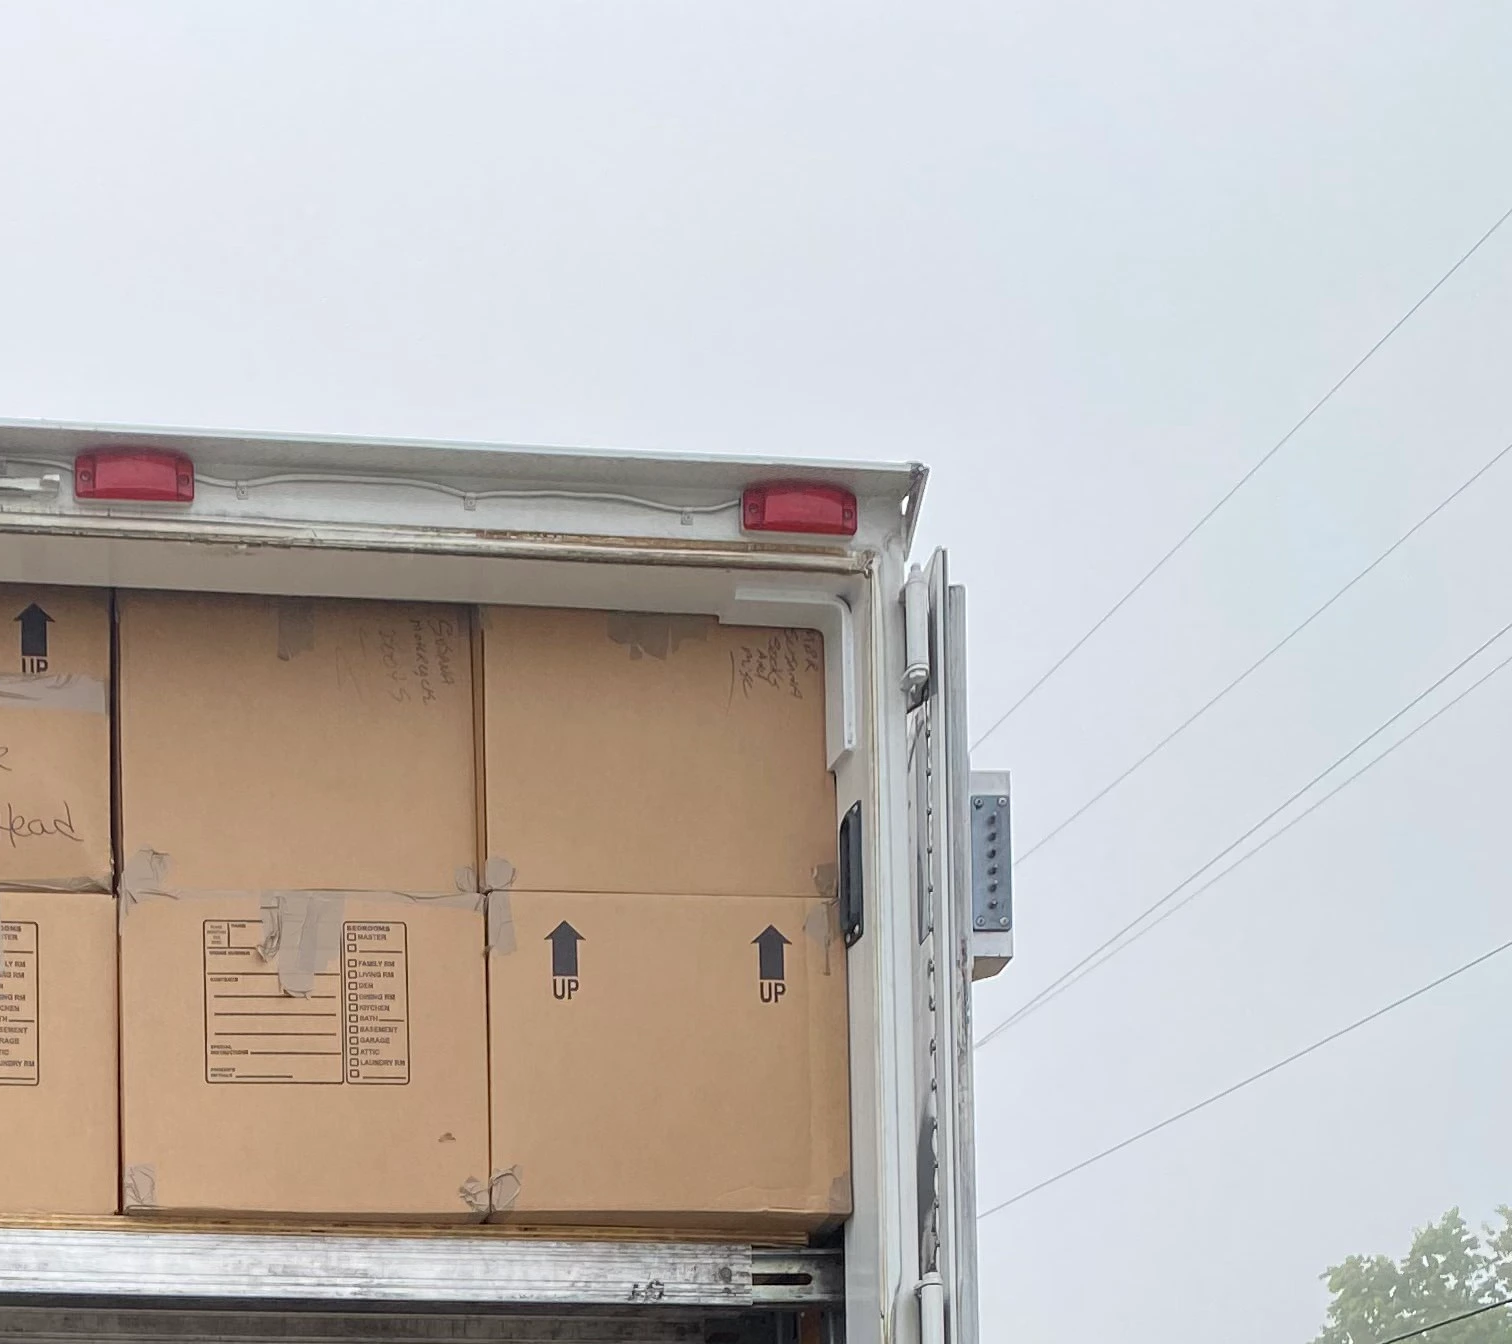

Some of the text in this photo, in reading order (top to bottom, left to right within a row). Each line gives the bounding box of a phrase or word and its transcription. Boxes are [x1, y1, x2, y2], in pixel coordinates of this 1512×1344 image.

[21, 658, 49, 674] UP
[357, 933, 387, 941] MASTER
[552, 978, 580, 1000] UP
[759, 981, 787, 1004] UP
[359, 1004, 390, 1012] KITCHEN
[360, 1059, 394, 1067] LAUNDRY
